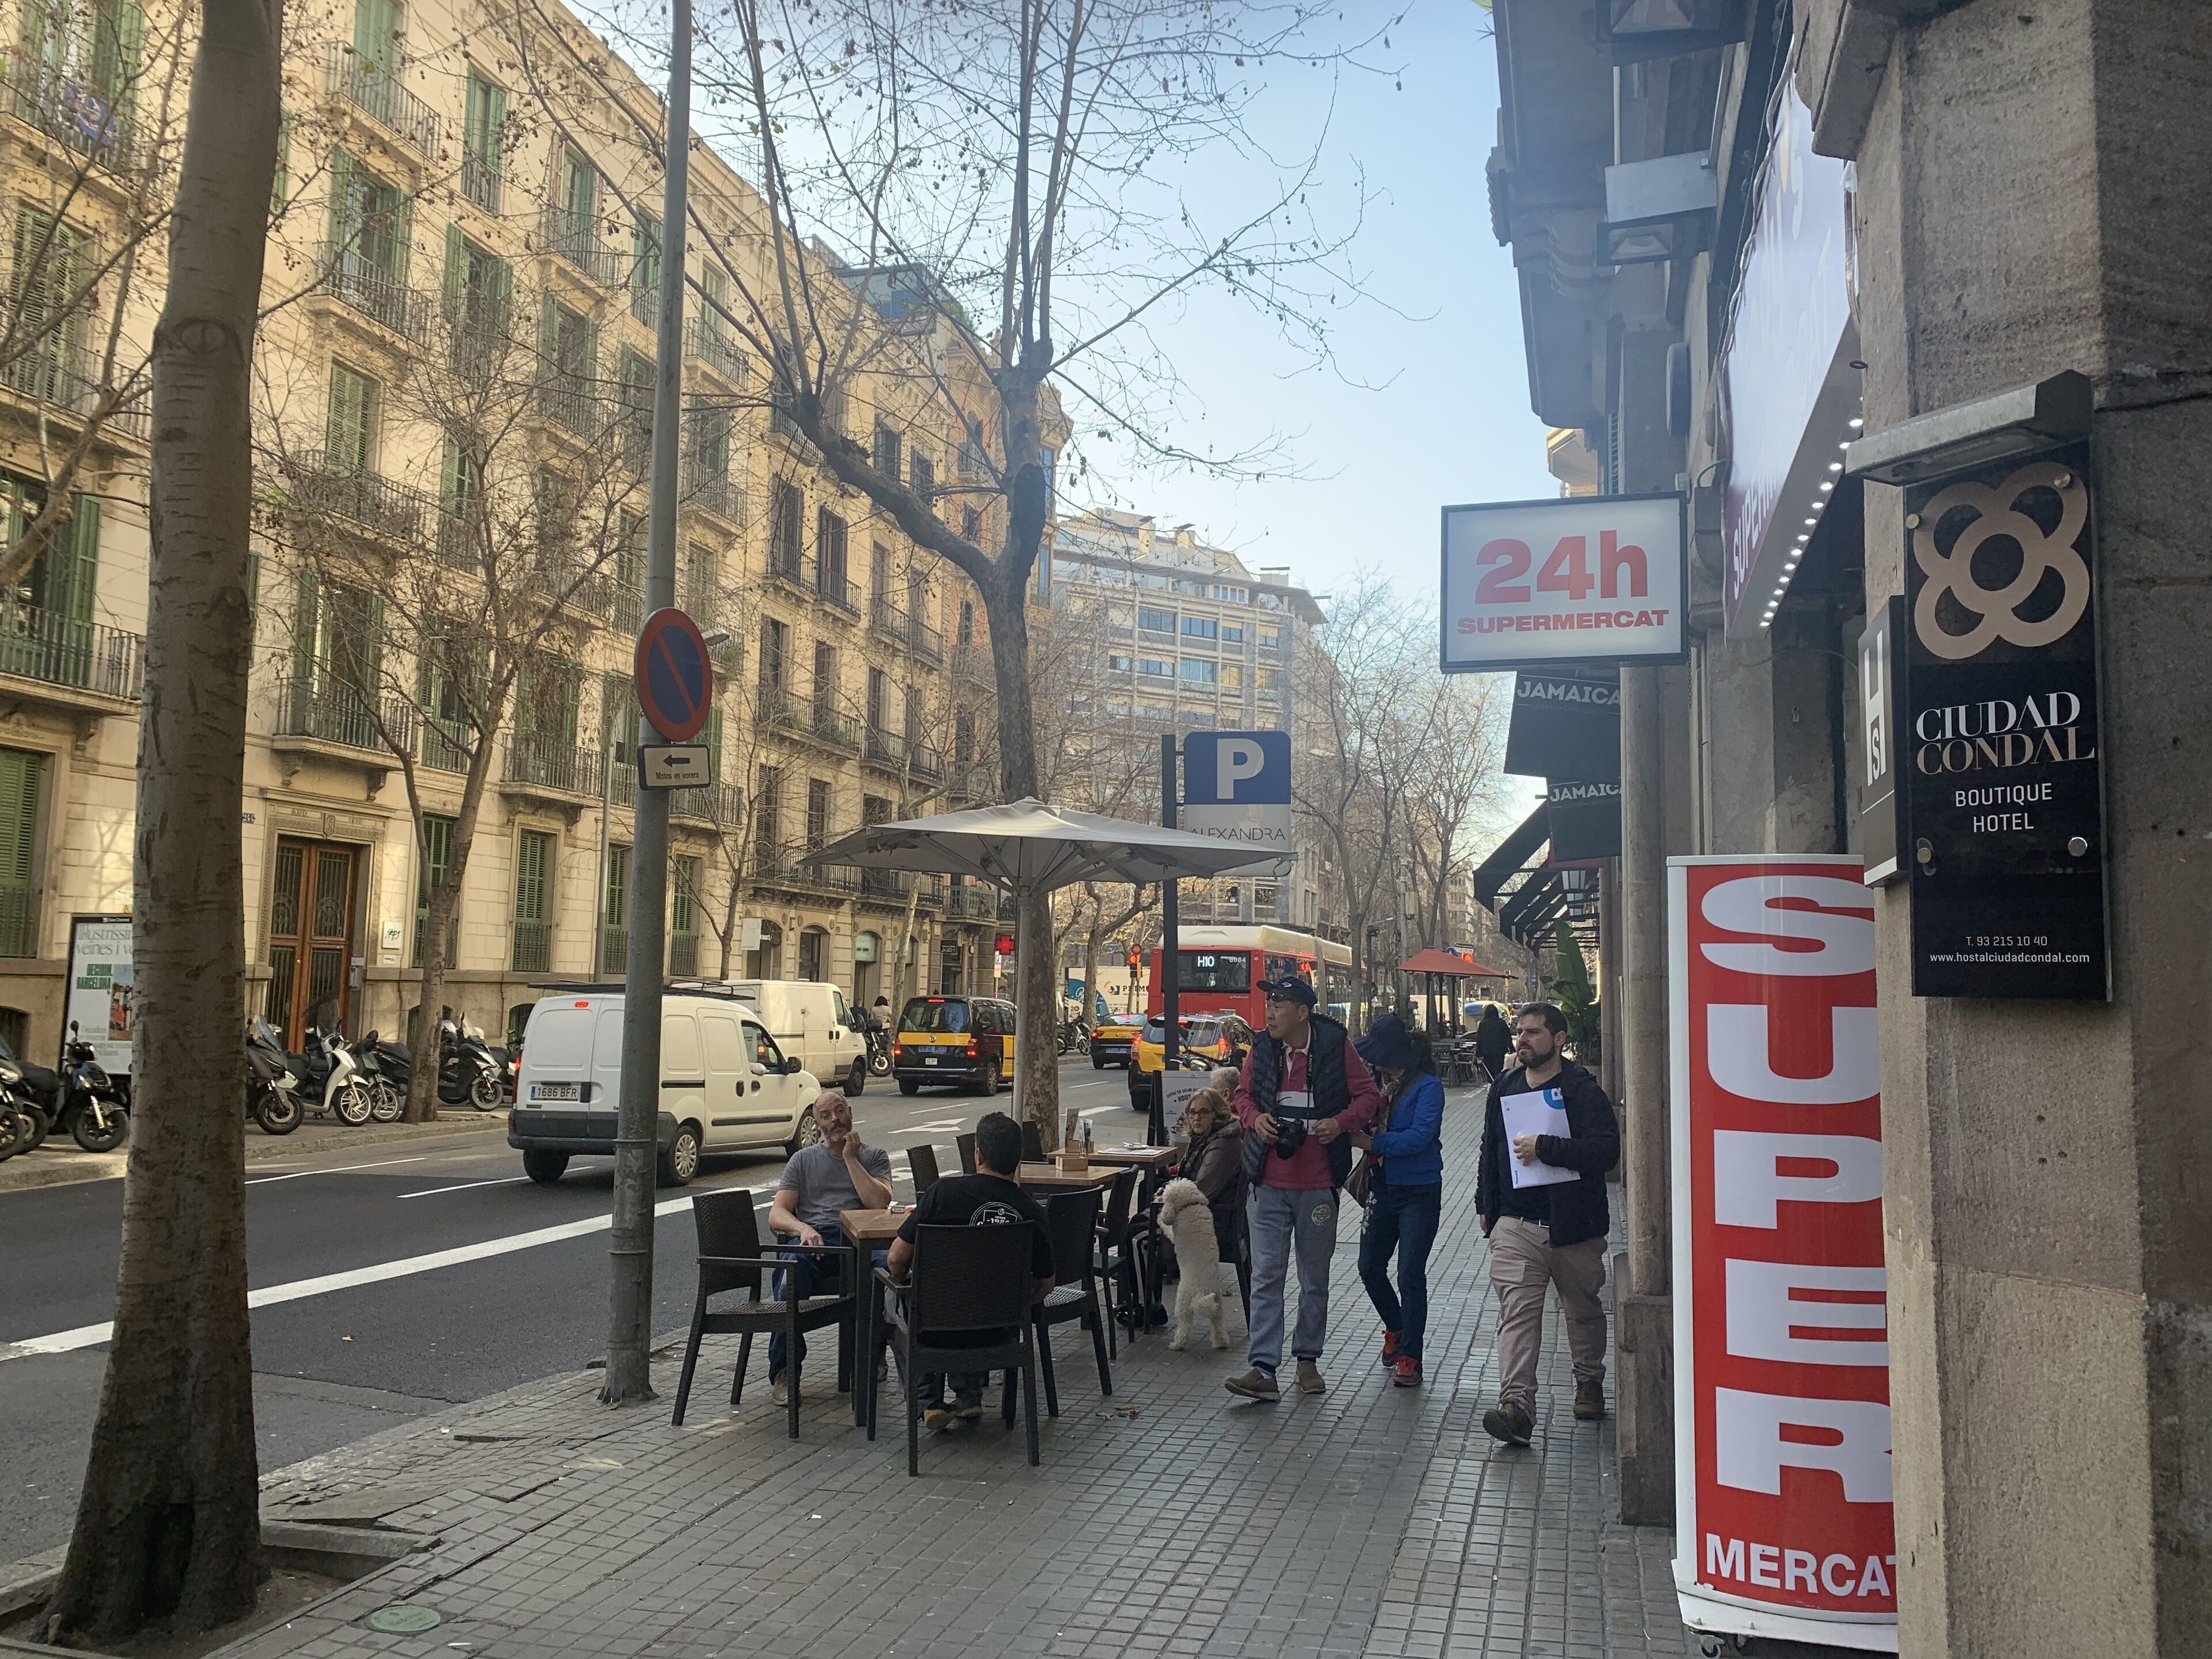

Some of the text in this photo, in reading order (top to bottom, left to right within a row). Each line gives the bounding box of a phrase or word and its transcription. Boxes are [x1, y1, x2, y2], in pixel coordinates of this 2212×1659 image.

[1475, 529, 1648, 604] 24h
[1457, 609, 1669, 634] SUPERMERCAT
[1916, 691, 2081, 741] CIUDAD
[1917, 726, 2095, 775] CONDAL
[1217, 738, 1264, 799] P
[1550, 783, 1621, 802] JAMAIC
[1956, 783, 2052, 806] BOUTIQUE
[1973, 813, 2034, 832] HOTEL
[1966, 936, 2047, 946] T. 93 215 10 40
[1198, 956, 1215, 967] H10
[1930, 952, 2090, 963] www.hostalciudadcondal.com
[537, 1088, 577, 1097] 1686 BFR
[1706, 1533, 1896, 1597] MERCA
